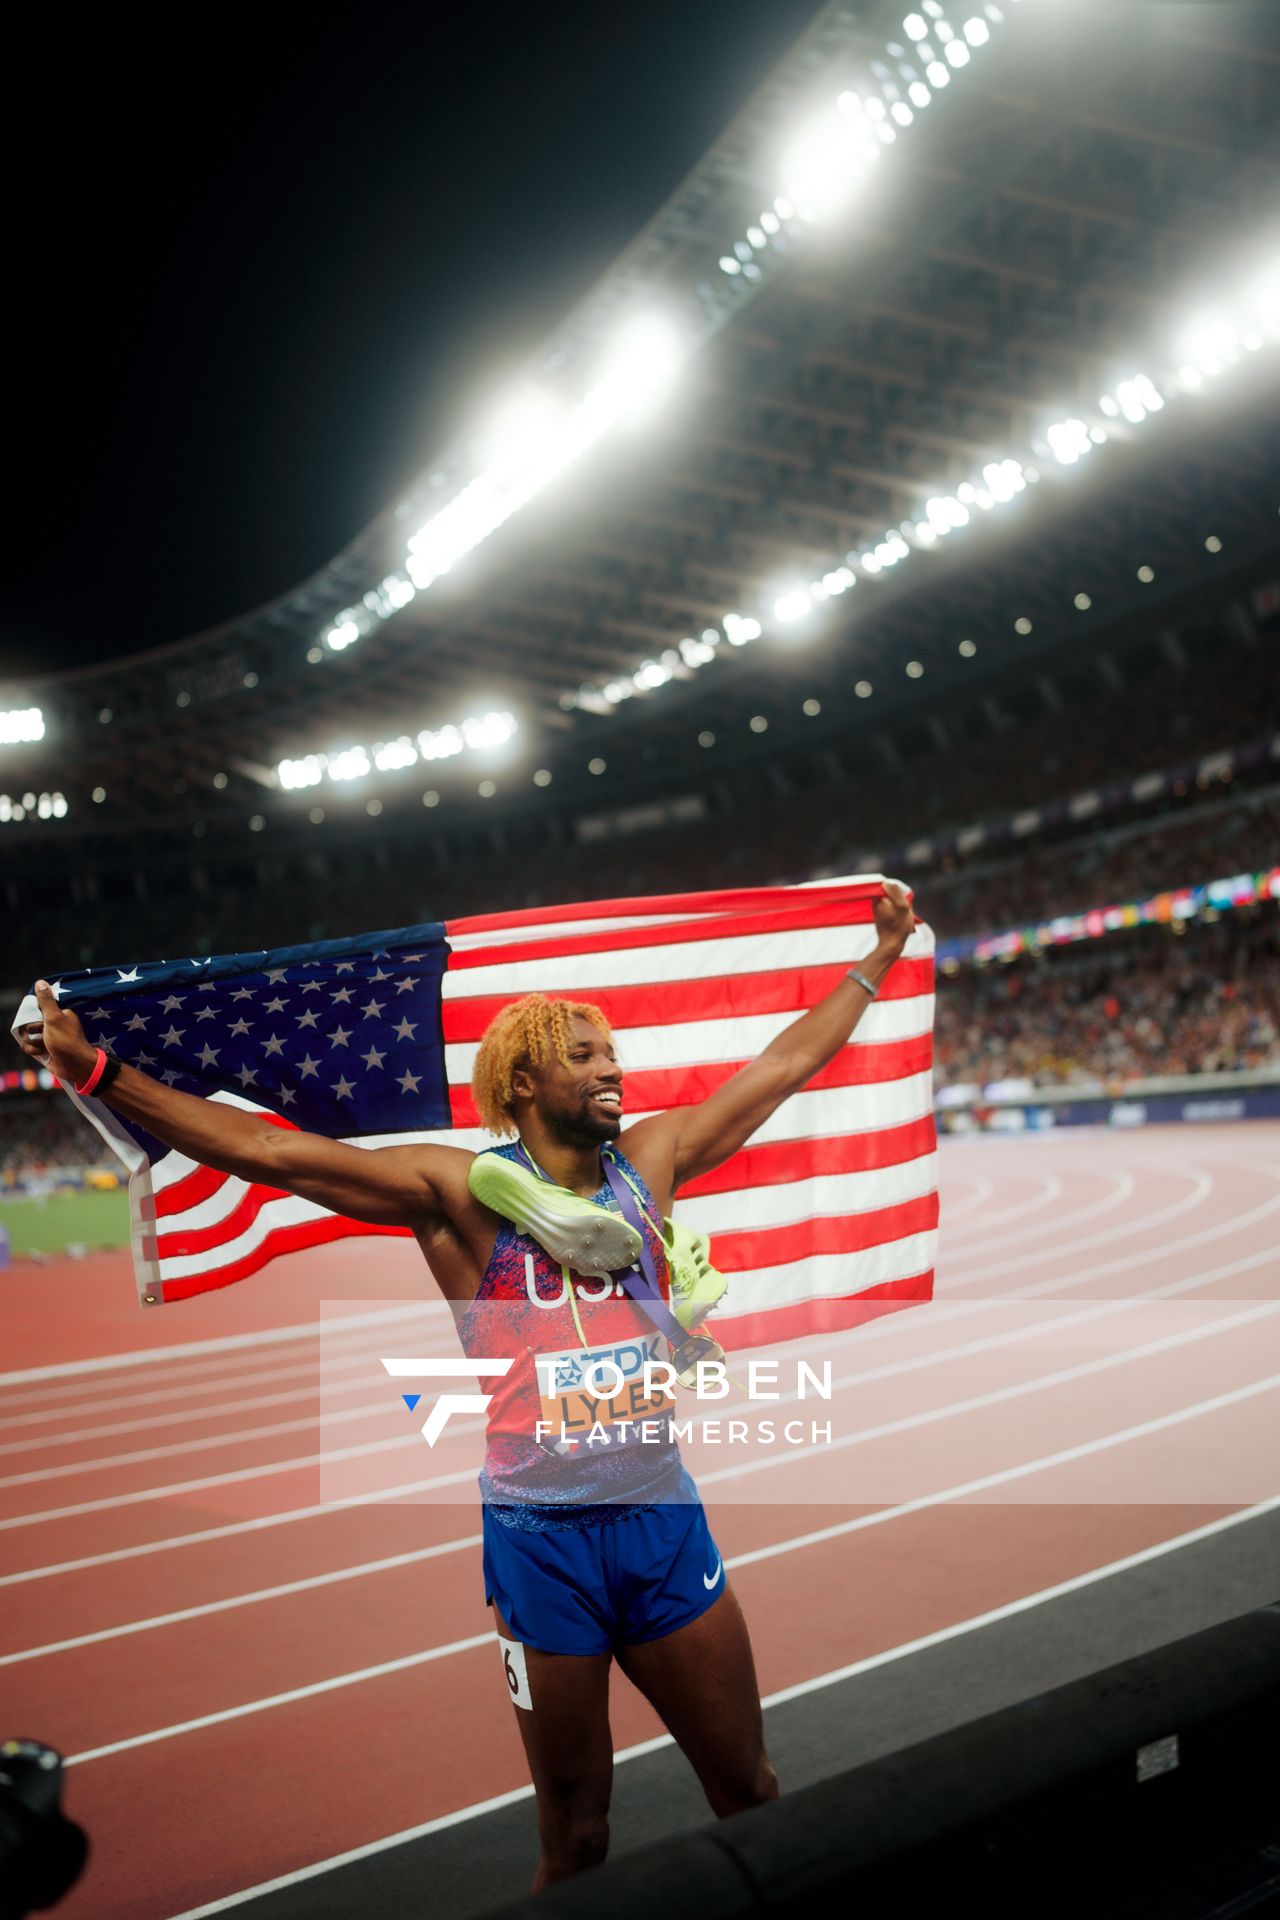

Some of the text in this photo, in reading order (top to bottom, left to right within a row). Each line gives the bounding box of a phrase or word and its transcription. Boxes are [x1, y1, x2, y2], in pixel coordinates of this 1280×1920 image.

[524, 1253, 641, 1309] US
[580, 1336, 661, 1382] TDK
[504, 1647, 519, 1695] 6
